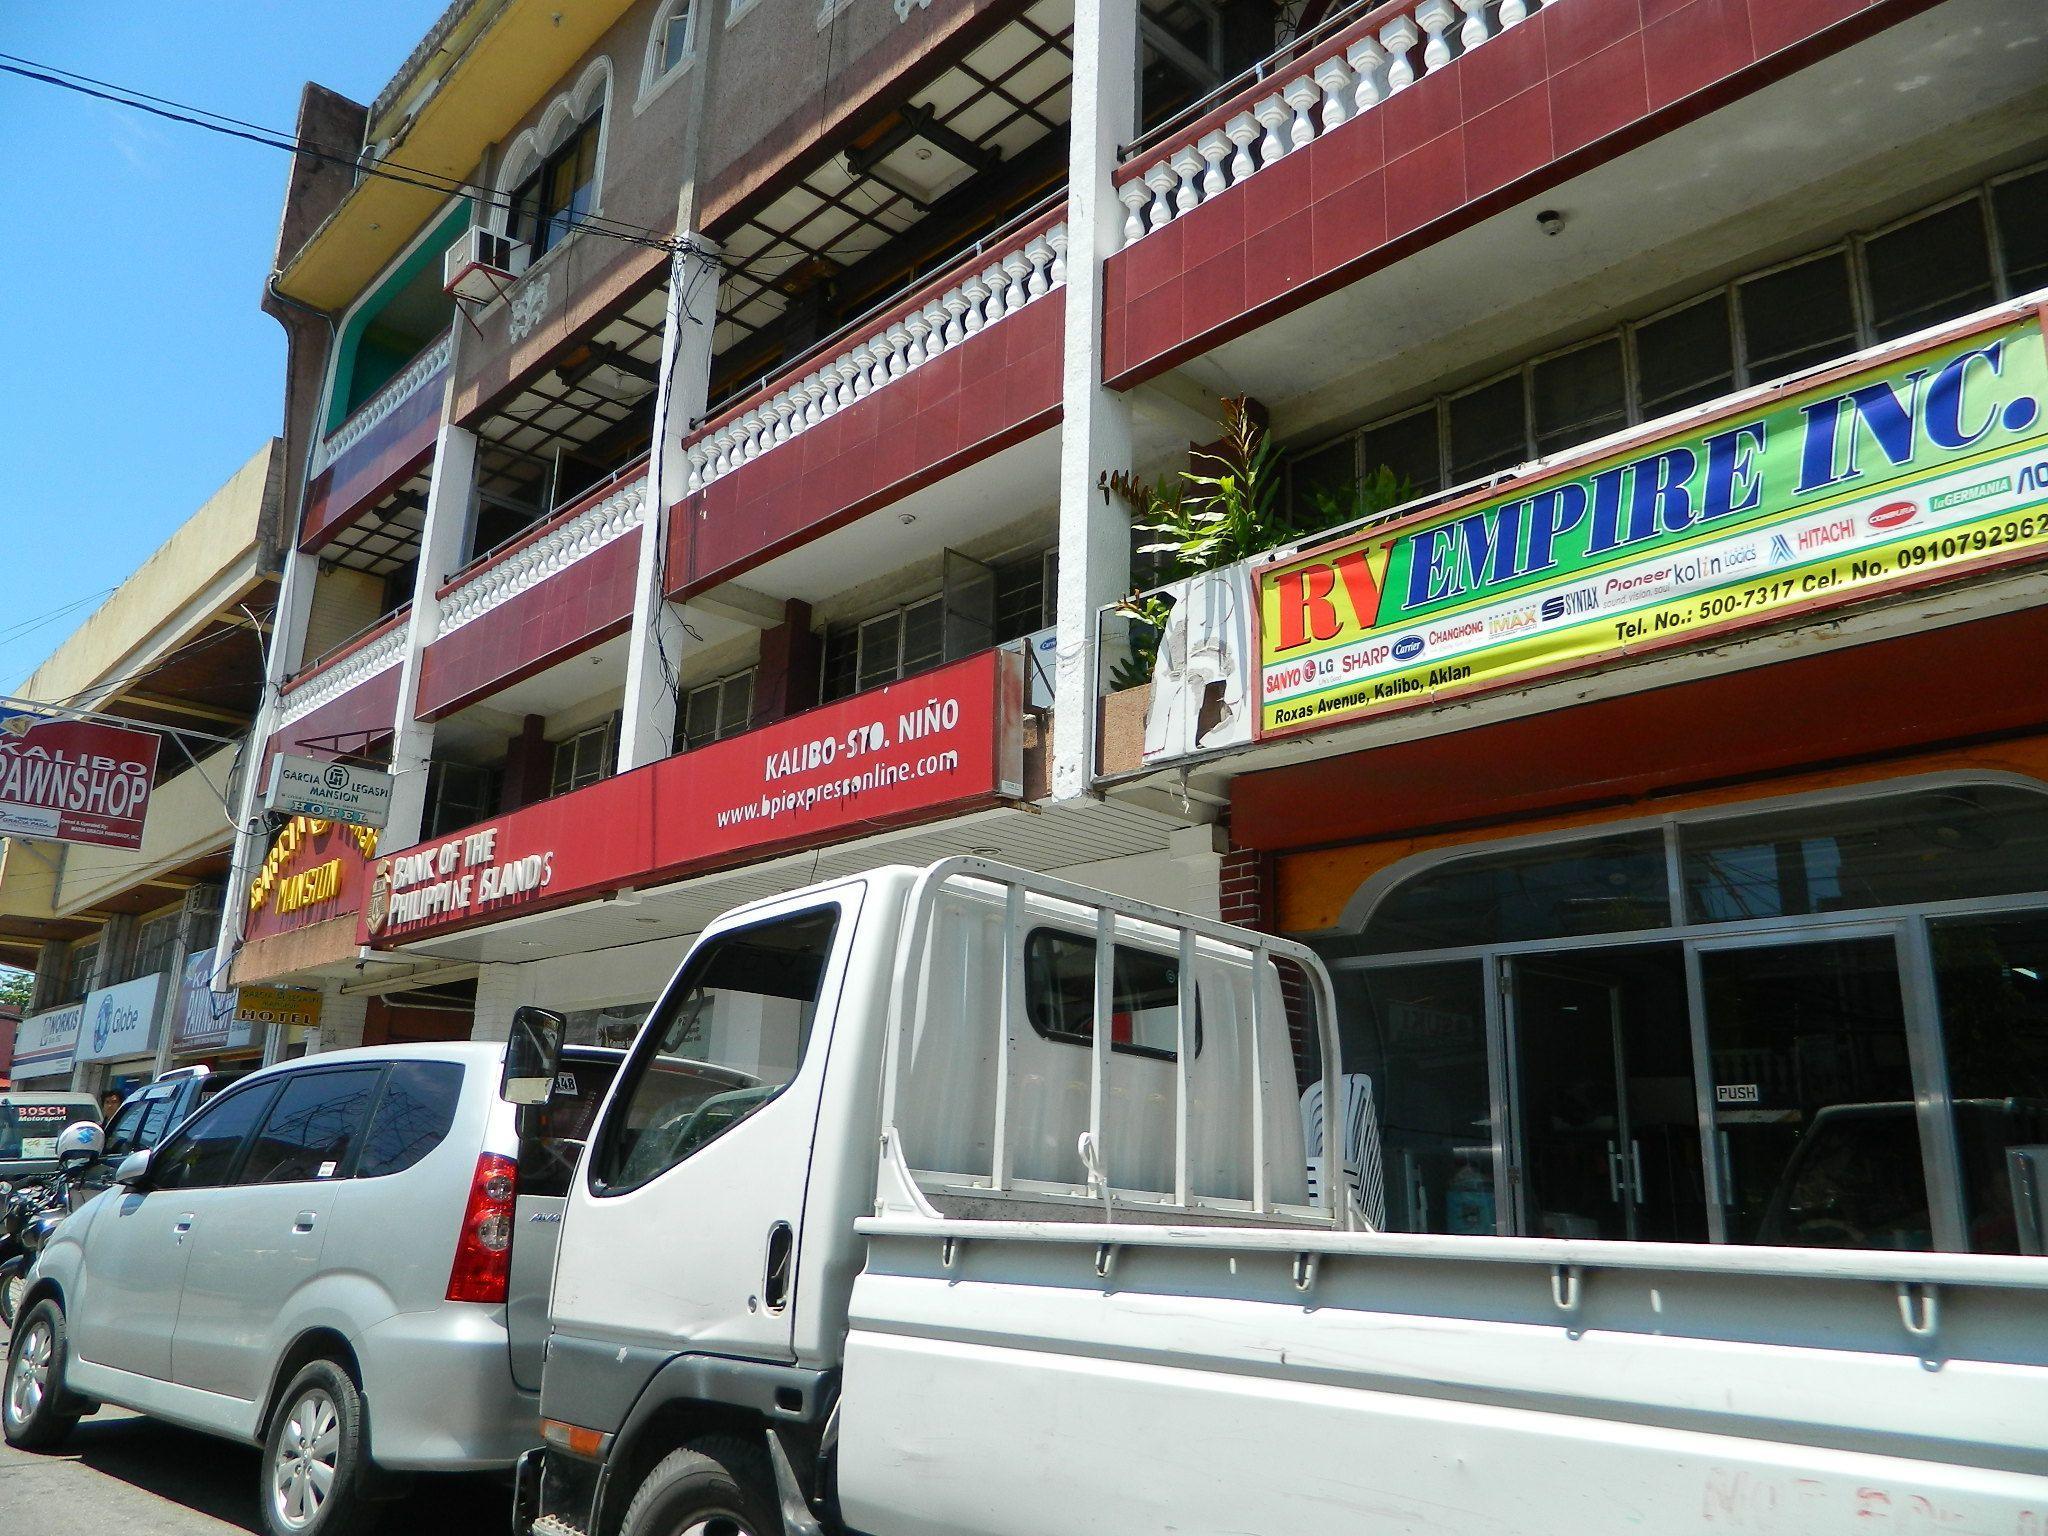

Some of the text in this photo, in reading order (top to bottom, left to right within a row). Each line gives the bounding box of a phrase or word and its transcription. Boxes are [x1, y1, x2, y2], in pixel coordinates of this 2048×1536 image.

[1274, 338, 2040, 653] RV EMPIRE INC.
[1266, 668, 1301, 694] SANYO
[1318, 658, 1334, 675] LG
[1342, 645, 1390, 673] SHARP
[1394, 640, 1422, 657] Carrier
[1429, 620, 1484, 645] CHANGHONG
[1565, 586, 1600, 616] SYNTAX
[1604, 568, 1673, 595] Pioneer
[1674, 556, 1721, 585] kolin
[1797, 518, 1856, 551] HITACHI
[1274, 703, 1314, 725] Roxas
[1317, 691, 1370, 714] Avenue,
[1374, 677, 1424, 700] Kalibo,
[1428, 664, 1471, 687] Aklan
[1615, 617, 1647, 641] Tel.
[1654, 609, 1693, 631] No.:
[1699, 579, 1795, 620] 500-7317
[1802, 568, 1843, 593] Cel.
[1852, 559, 1889, 582] No.
[898, 697, 960, 744] NIÑO
[0, 739, 148, 776] KALIBO
[282, 769, 390, 798] GARCIA LEGASPI
[309, 786, 359, 803] MANSION
[716, 749, 959, 828] www.bpiexpressonline.com
[291, 801, 369, 823] HOTEL
[392, 827, 498, 890] BANK OF THE
[275, 857, 343, 915] MANSION
[387, 851, 554, 927] PHILIPPINE ISLANDS
[112, 1006, 139, 1034] Globe
[240, 1008, 311, 1026] HOTEL
[18, 1106, 67, 1117] BOSCH
[1718, 1086, 1757, 1100] PUSH
